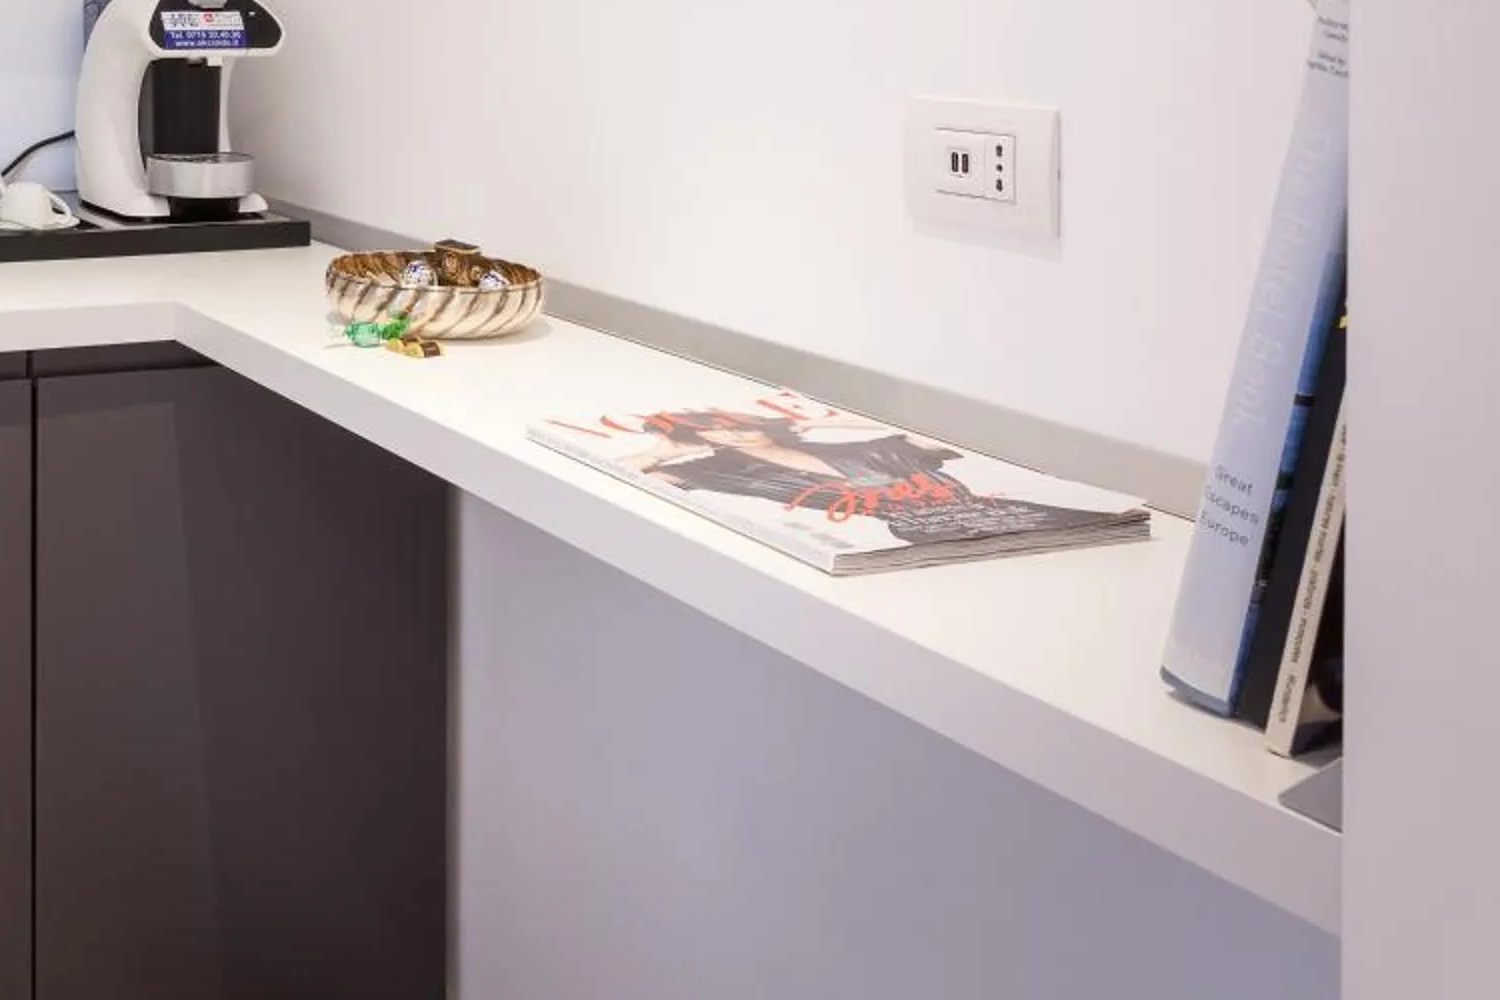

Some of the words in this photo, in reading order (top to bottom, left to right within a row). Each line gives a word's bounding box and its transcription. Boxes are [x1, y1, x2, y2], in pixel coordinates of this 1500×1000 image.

[1214, 464, 1253, 496] Great
[1203, 484, 1259, 525] Escapes
[1199, 509, 1249, 547] Europe
